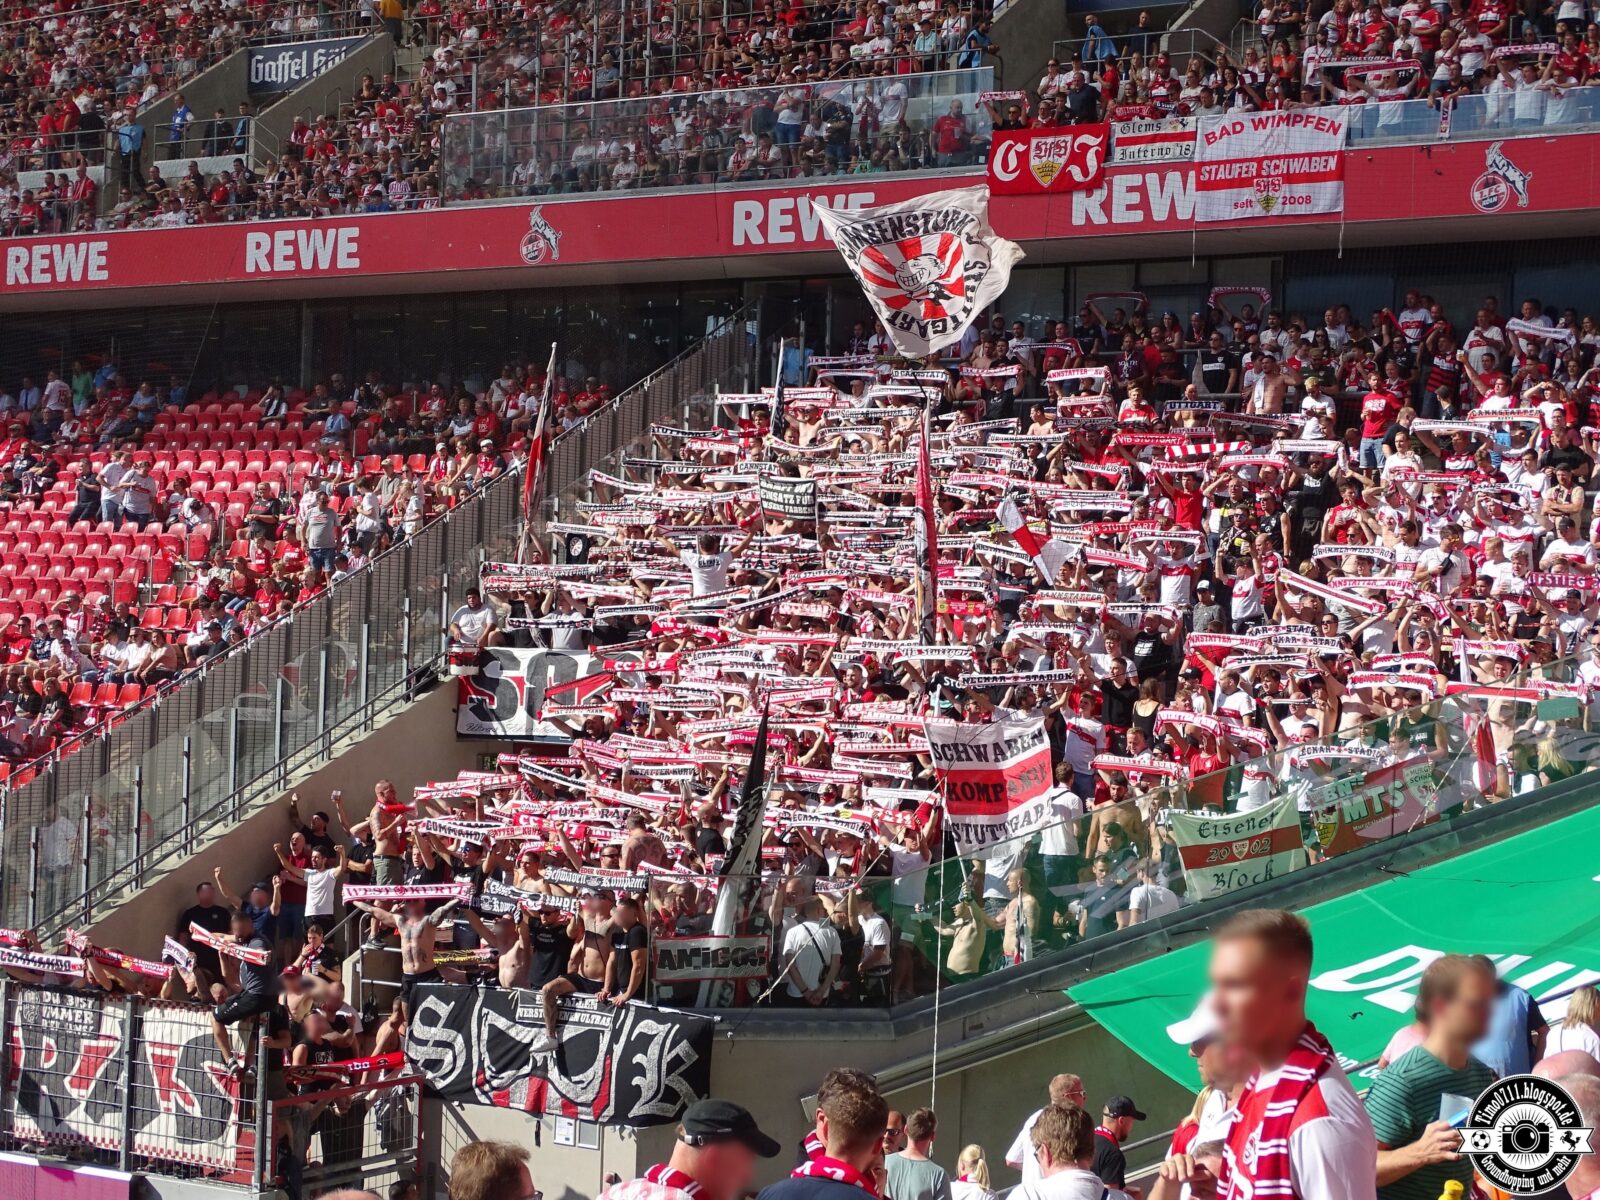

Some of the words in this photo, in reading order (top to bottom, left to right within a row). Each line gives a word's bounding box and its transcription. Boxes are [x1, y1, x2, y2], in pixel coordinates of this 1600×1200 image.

[251, 50, 307, 83] Gaffel
[1120, 122, 1162, 134] Glems
[1204, 121, 1245, 145] BAD
[1251, 113, 1342, 136] WIMPFEN
[1119, 147, 1171, 160] Inferno
[1200, 162, 1257, 181] STAUFER
[1262, 155, 1338, 176] SCHWABEN
[1071, 170, 1195, 226] REW
[1234, 199, 1253, 210] seit
[1281, 195, 1312, 205] 2008
[245, 228, 360, 274] REWE
[6, 241, 109, 286] REWE
[1102, 521, 1154, 533] STUTTGART
[921, 647, 972, 657] Stuttgart
[1025, 672, 1074, 682] STADION
[933, 726, 1044, 763] SCHWABEN
[1342, 780, 1407, 824] MTS
[1198, 812, 1279, 839] Eisener
[1207, 847, 1231, 863] 20
[1250, 838, 1271, 854] 02
[345, 886, 391, 897] WEST
[43, 991, 61, 1003] DU
[42, 1007, 93, 1024] IMMER
[518, 1008, 580, 1025] VERSTENEN
[580, 1012, 613, 1027] ULTRAS
